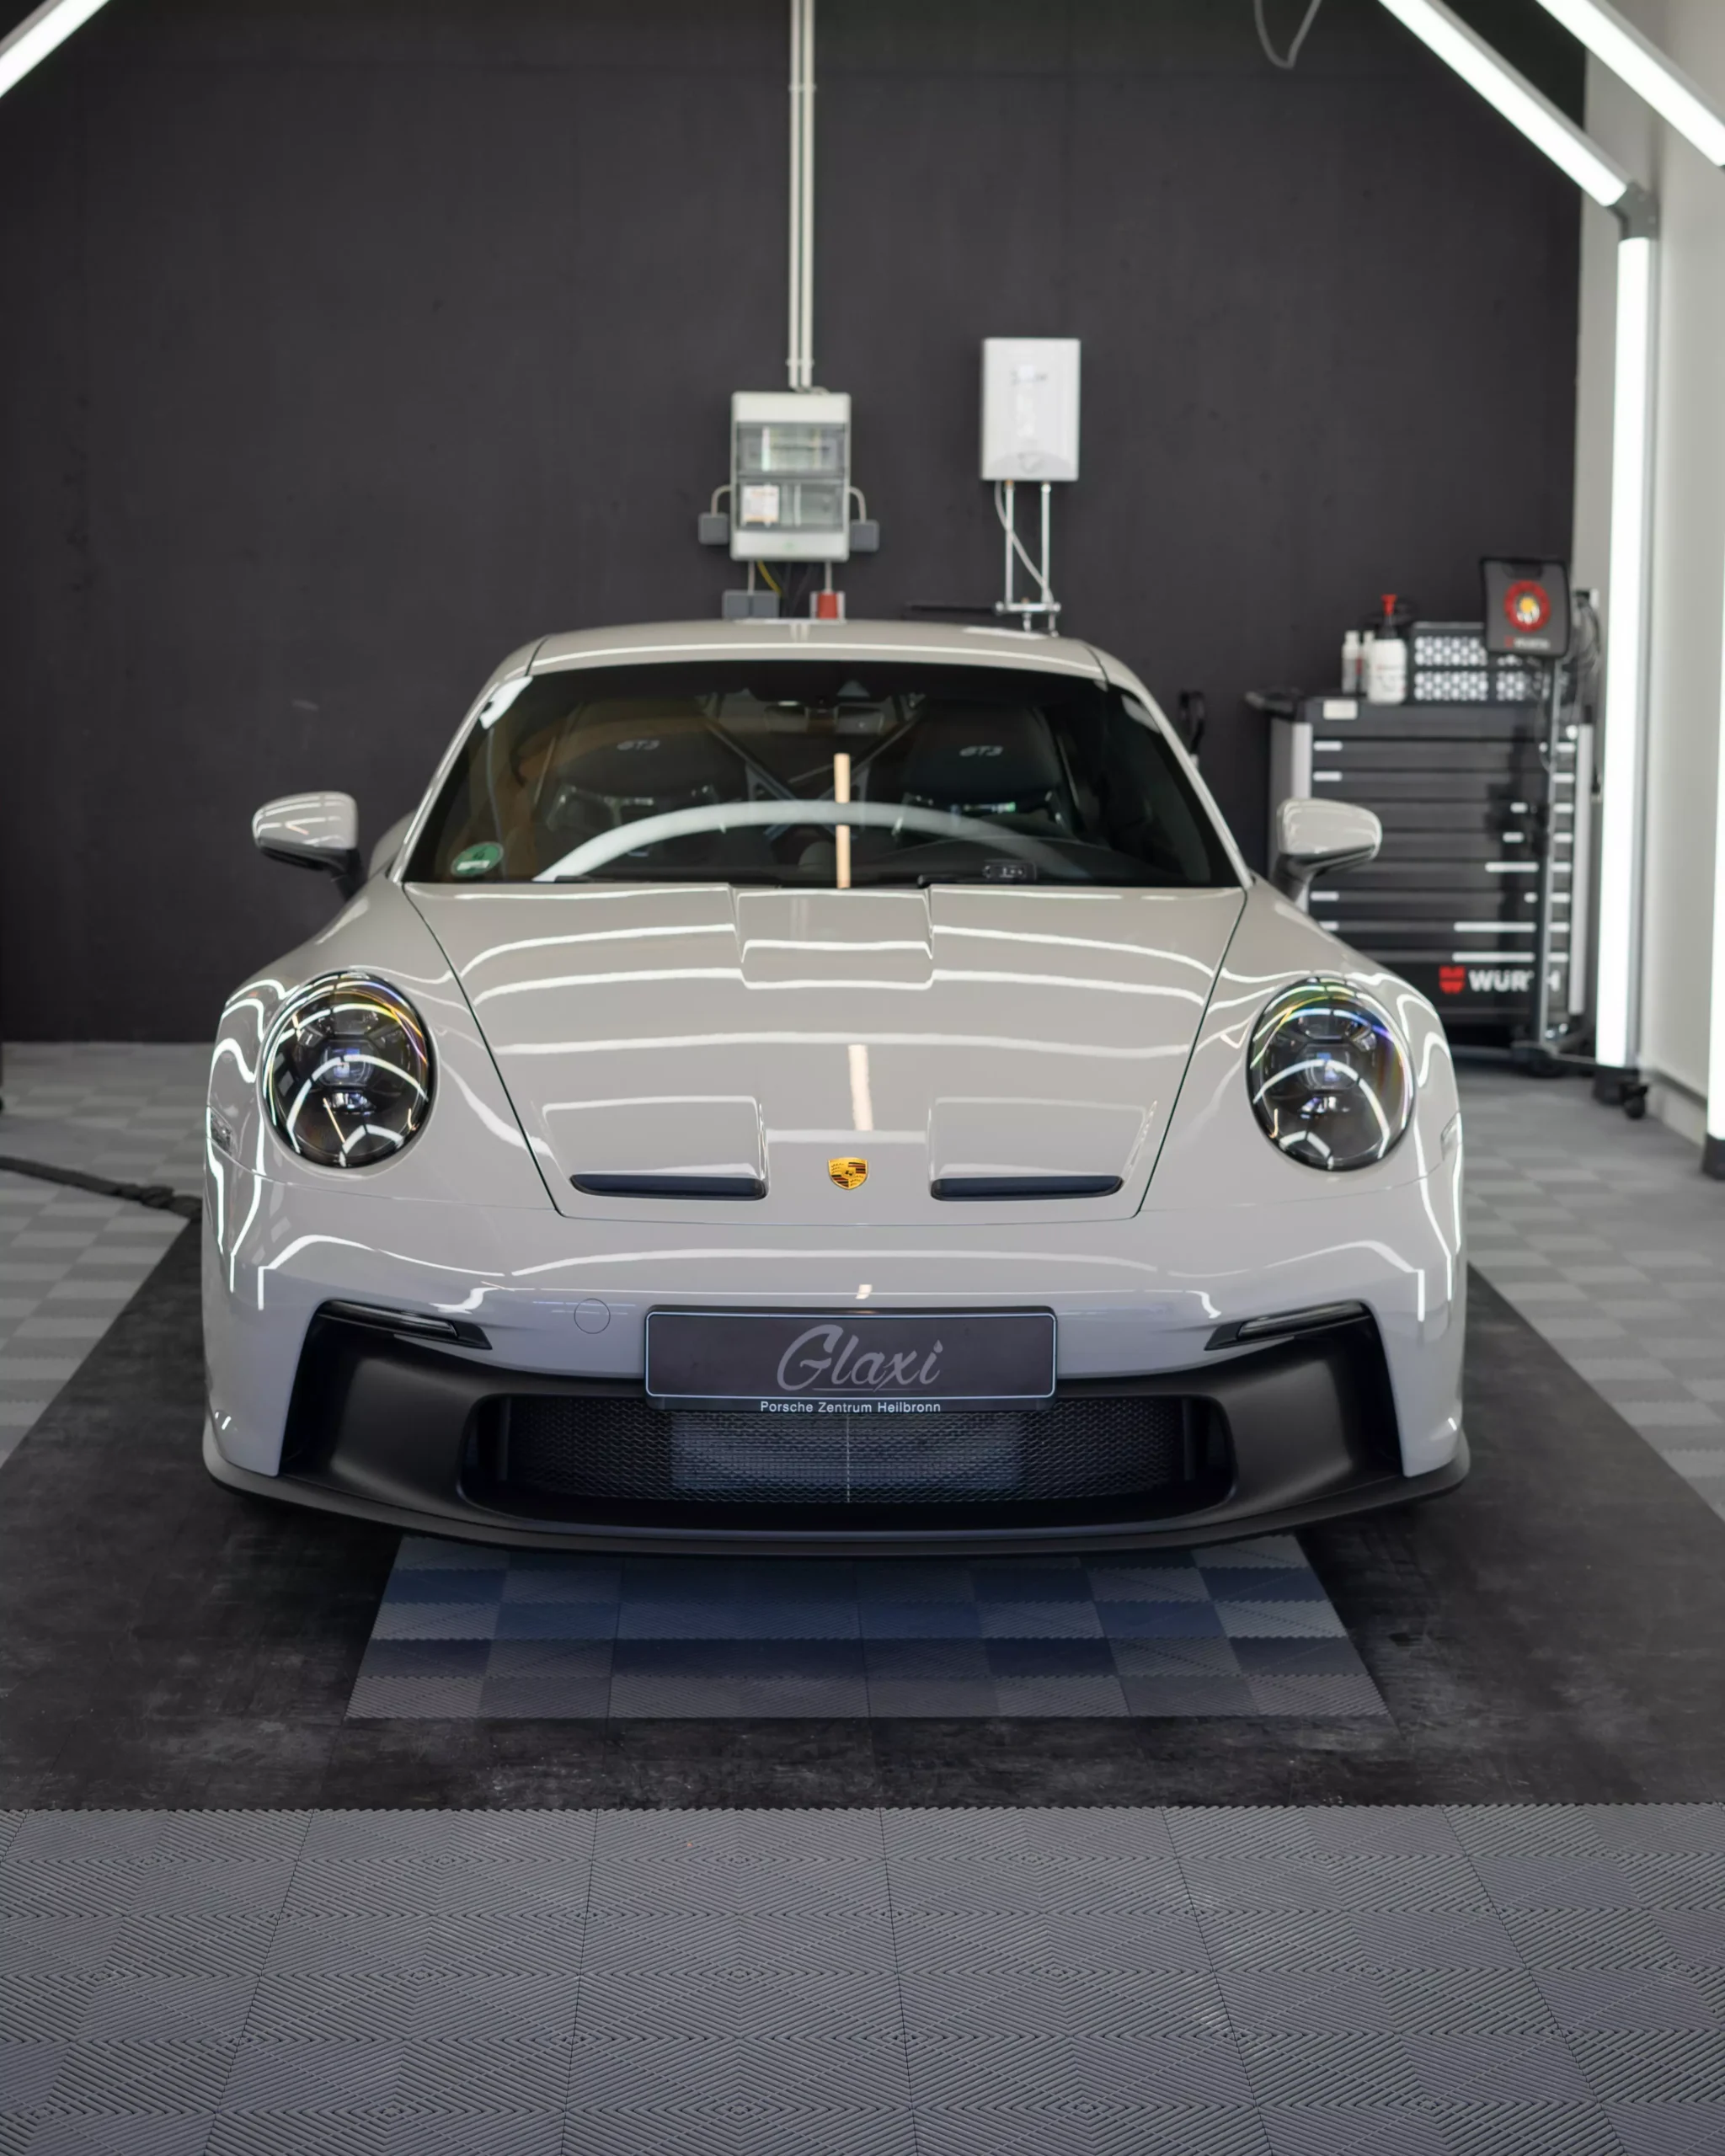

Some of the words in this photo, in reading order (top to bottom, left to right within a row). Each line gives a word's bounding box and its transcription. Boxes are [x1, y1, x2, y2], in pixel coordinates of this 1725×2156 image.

[959, 744, 1004, 757] GT3
[777, 1324, 943, 1392] Glaxi
[761, 1401, 814, 1412] Porsche
[818, 1401, 873, 1413] Zentrum
[878, 1401, 941, 1412] Heilbronn
